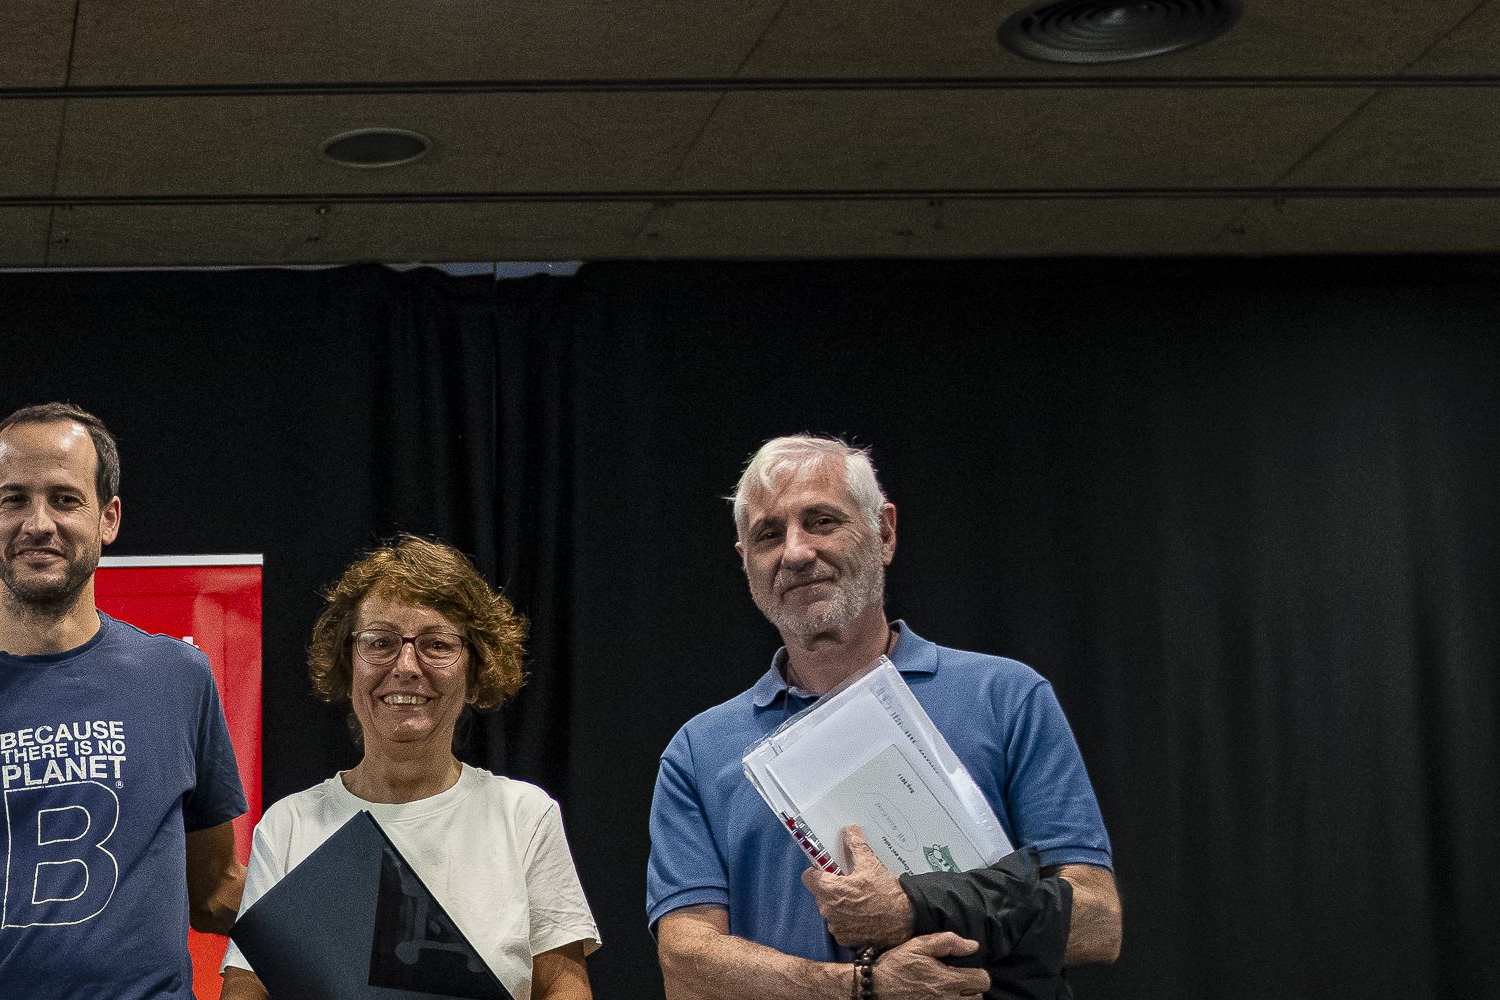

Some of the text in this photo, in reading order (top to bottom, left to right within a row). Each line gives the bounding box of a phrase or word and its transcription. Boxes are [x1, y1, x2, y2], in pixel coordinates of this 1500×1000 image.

[0, 720, 125, 751] BECAUSE
[0, 739, 126, 764] THERE IS NO
[1, 755, 127, 789] PLANET
[0, 780, 119, 930] B
